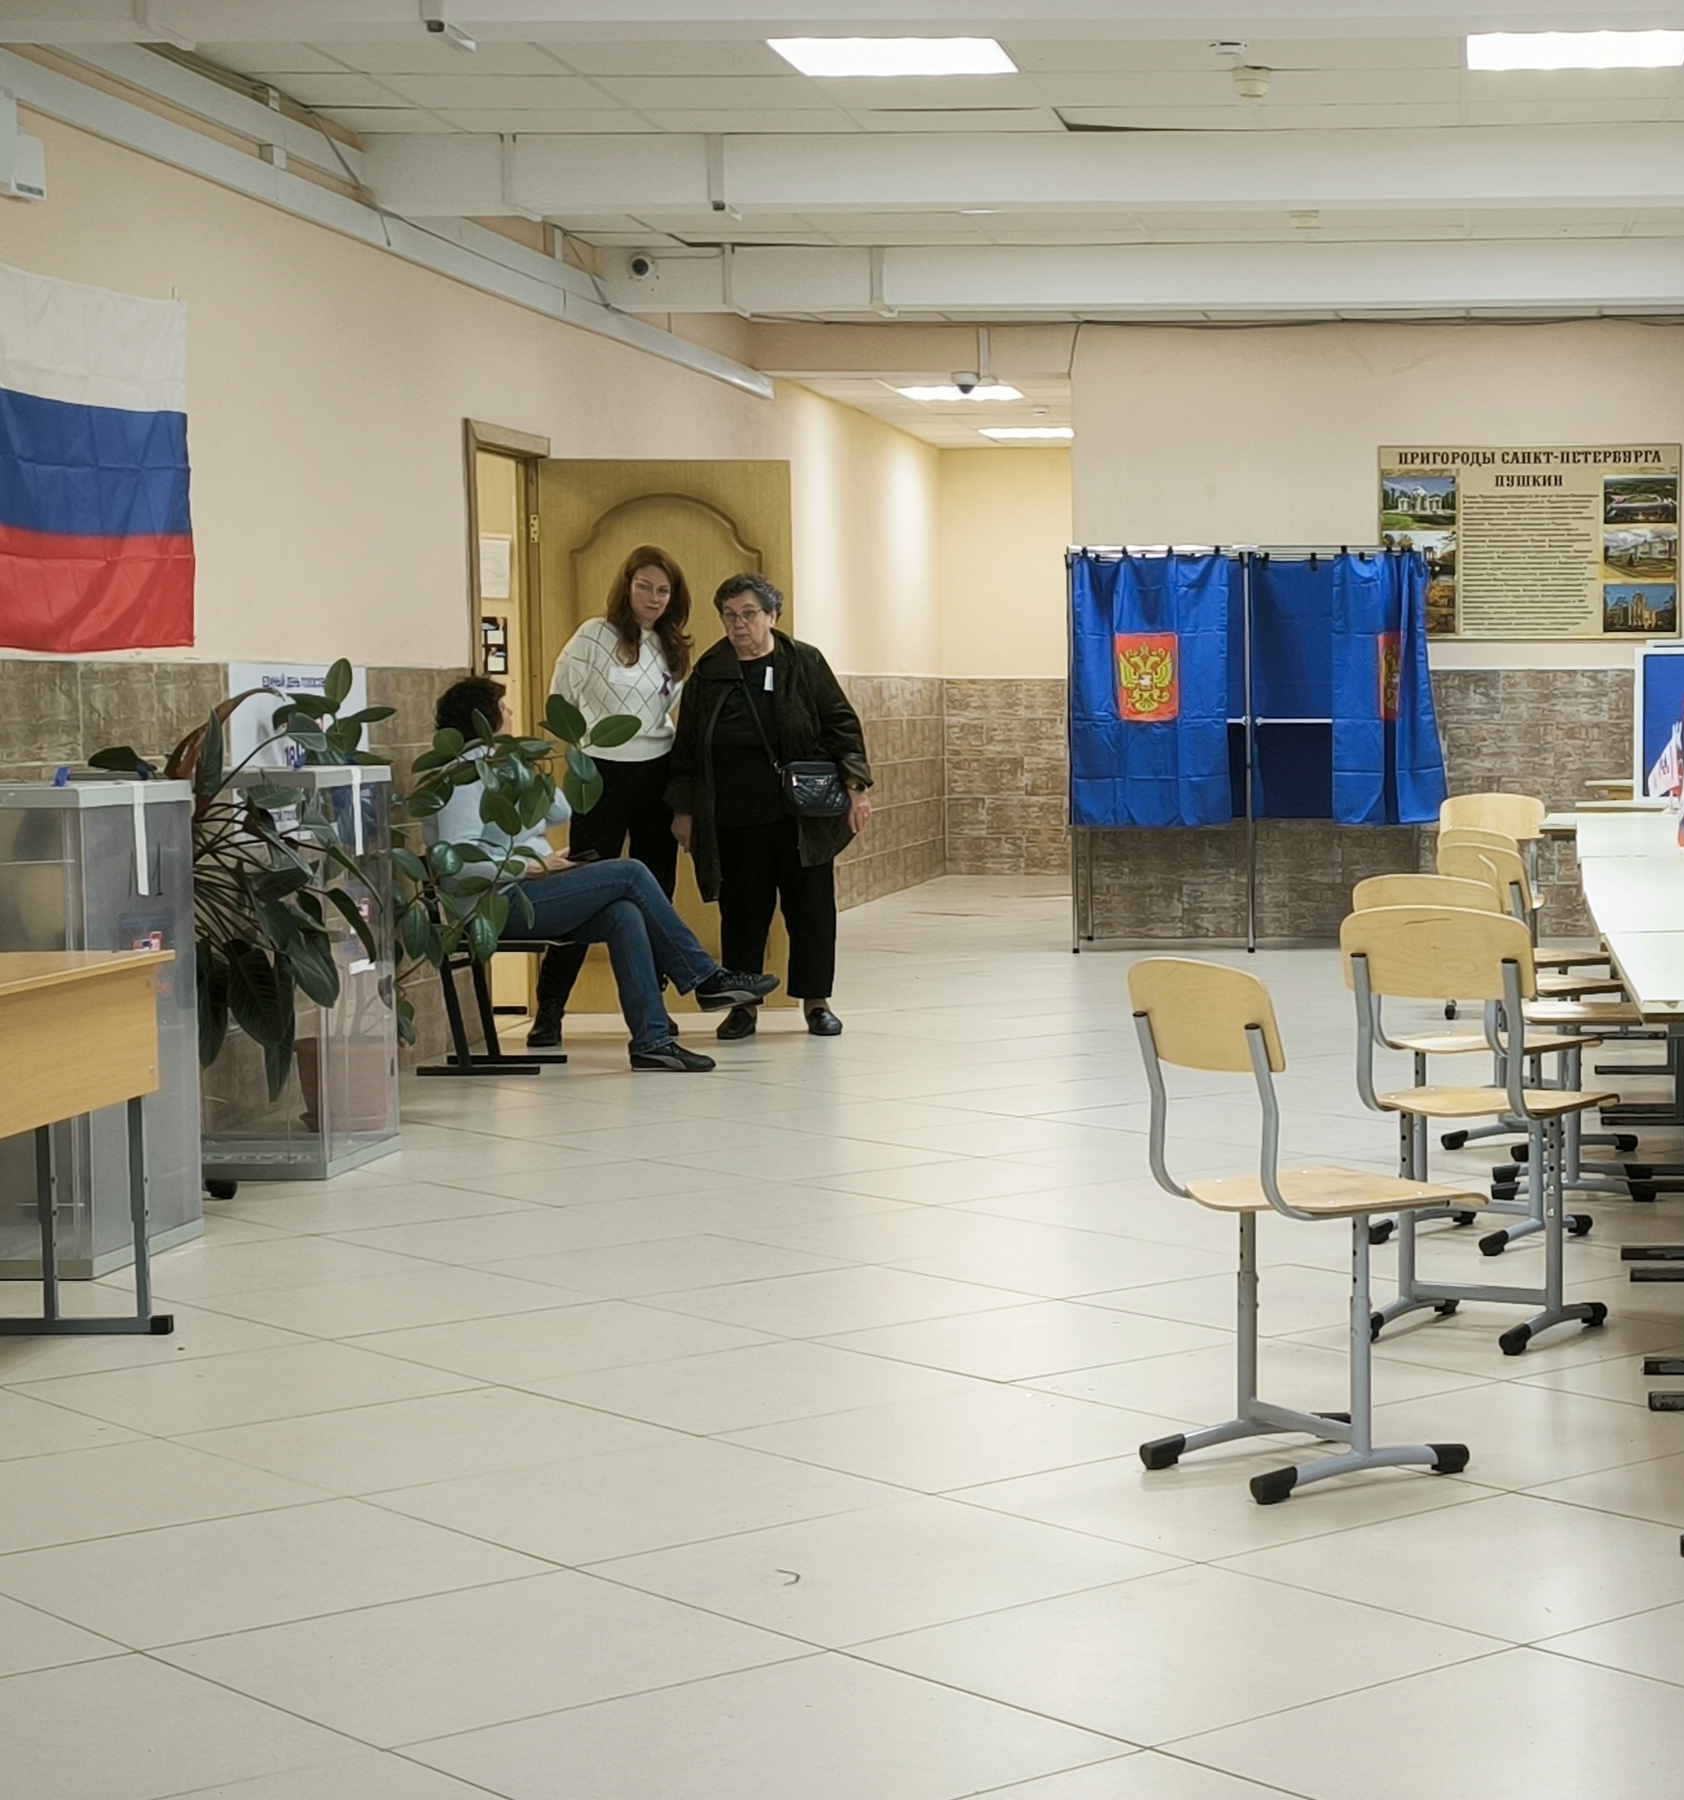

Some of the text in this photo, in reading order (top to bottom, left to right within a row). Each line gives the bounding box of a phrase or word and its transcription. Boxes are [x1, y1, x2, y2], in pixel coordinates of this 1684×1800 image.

[1397, 450, 1663, 467] ПРИГОРОДЫ САНКТ-ПЕТЕРБУРГА
[1494, 474, 1564, 488] ПУШКИН
